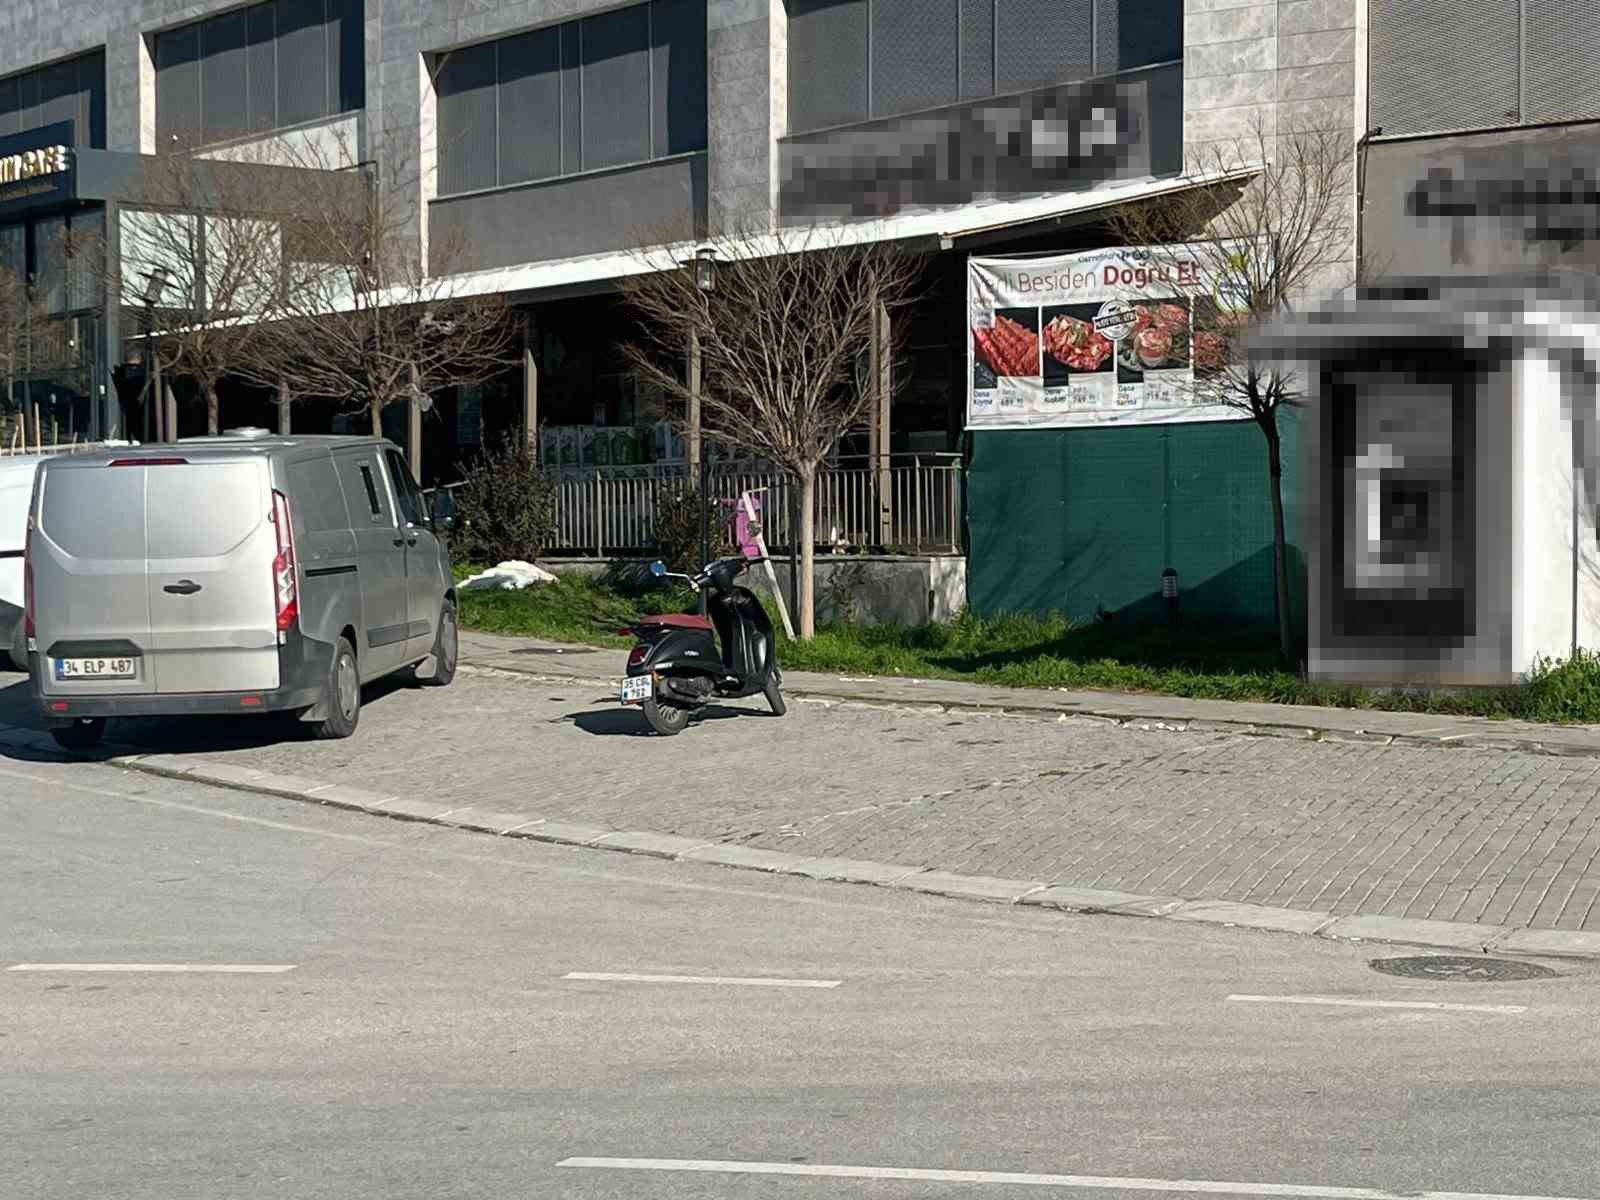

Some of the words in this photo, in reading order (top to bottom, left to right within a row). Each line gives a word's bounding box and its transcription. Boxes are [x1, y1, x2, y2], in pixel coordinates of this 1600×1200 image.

[1017, 268, 1096, 293] Besiden
[1103, 263, 1171, 289] Doğru
[1176, 259, 1202, 284] Et
[64, 660, 78, 674] 34
[83, 660, 105, 674] ELP
[111, 659, 132, 673] 487
